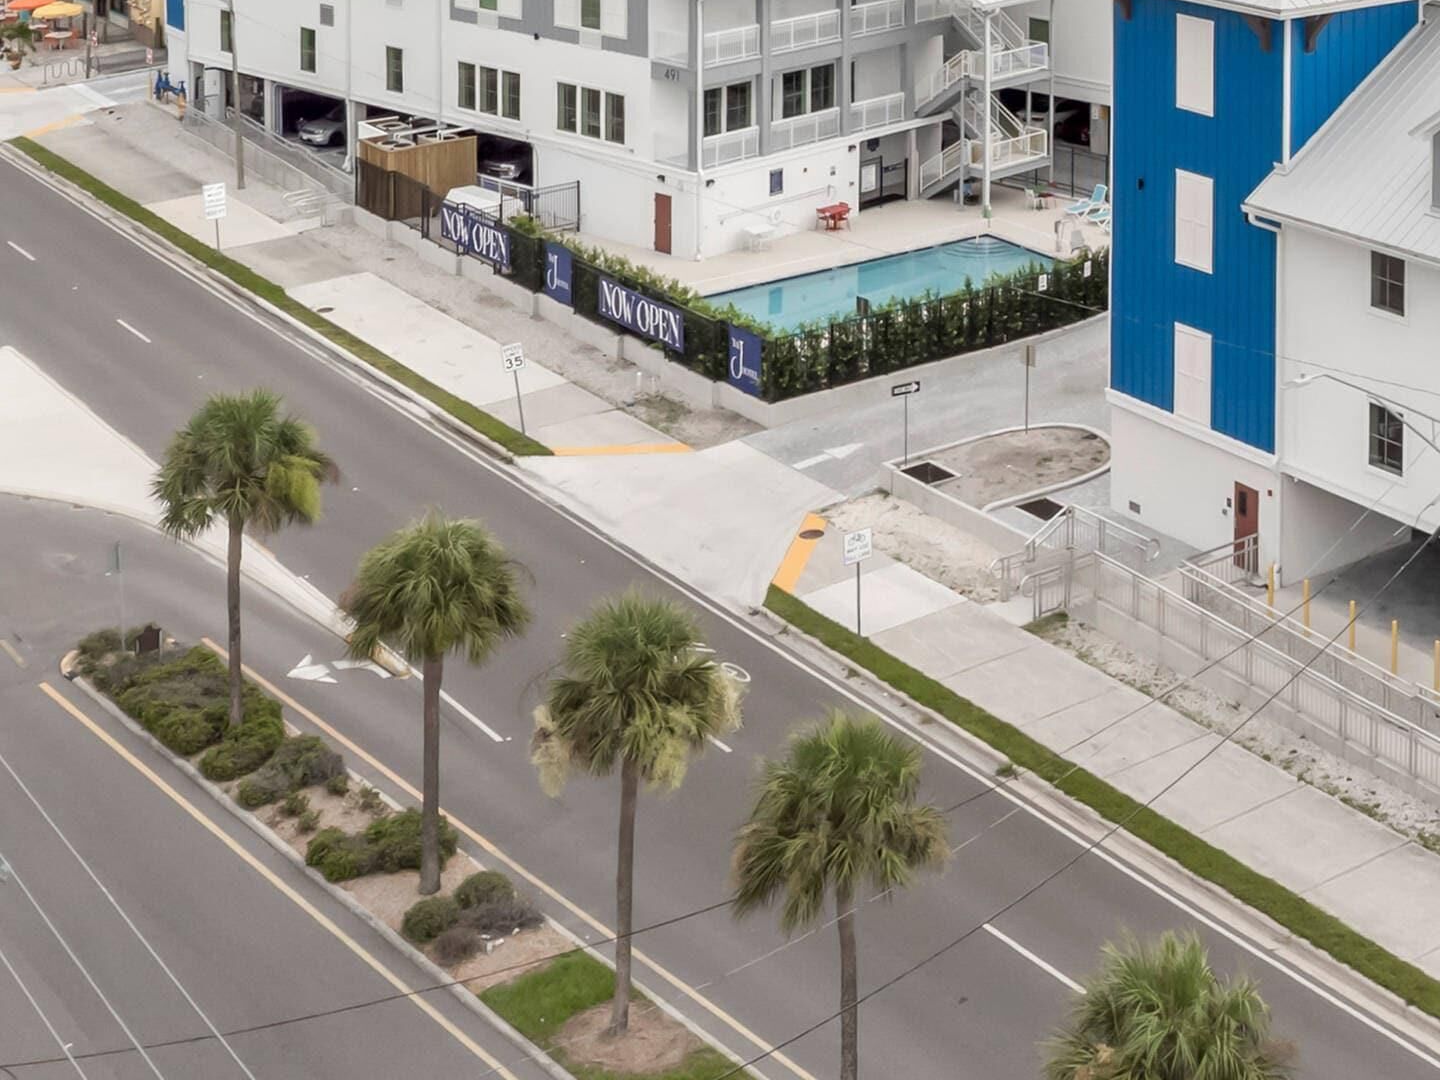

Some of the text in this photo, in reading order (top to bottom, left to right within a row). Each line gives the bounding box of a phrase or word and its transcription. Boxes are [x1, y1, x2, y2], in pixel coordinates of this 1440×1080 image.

[664, 68, 680, 81] 491
[442, 207, 507, 264] NOW OPEN
[602, 280, 680, 347] NOW OPEN
[505, 355, 523, 369] 35
[730, 340, 744, 379] J
